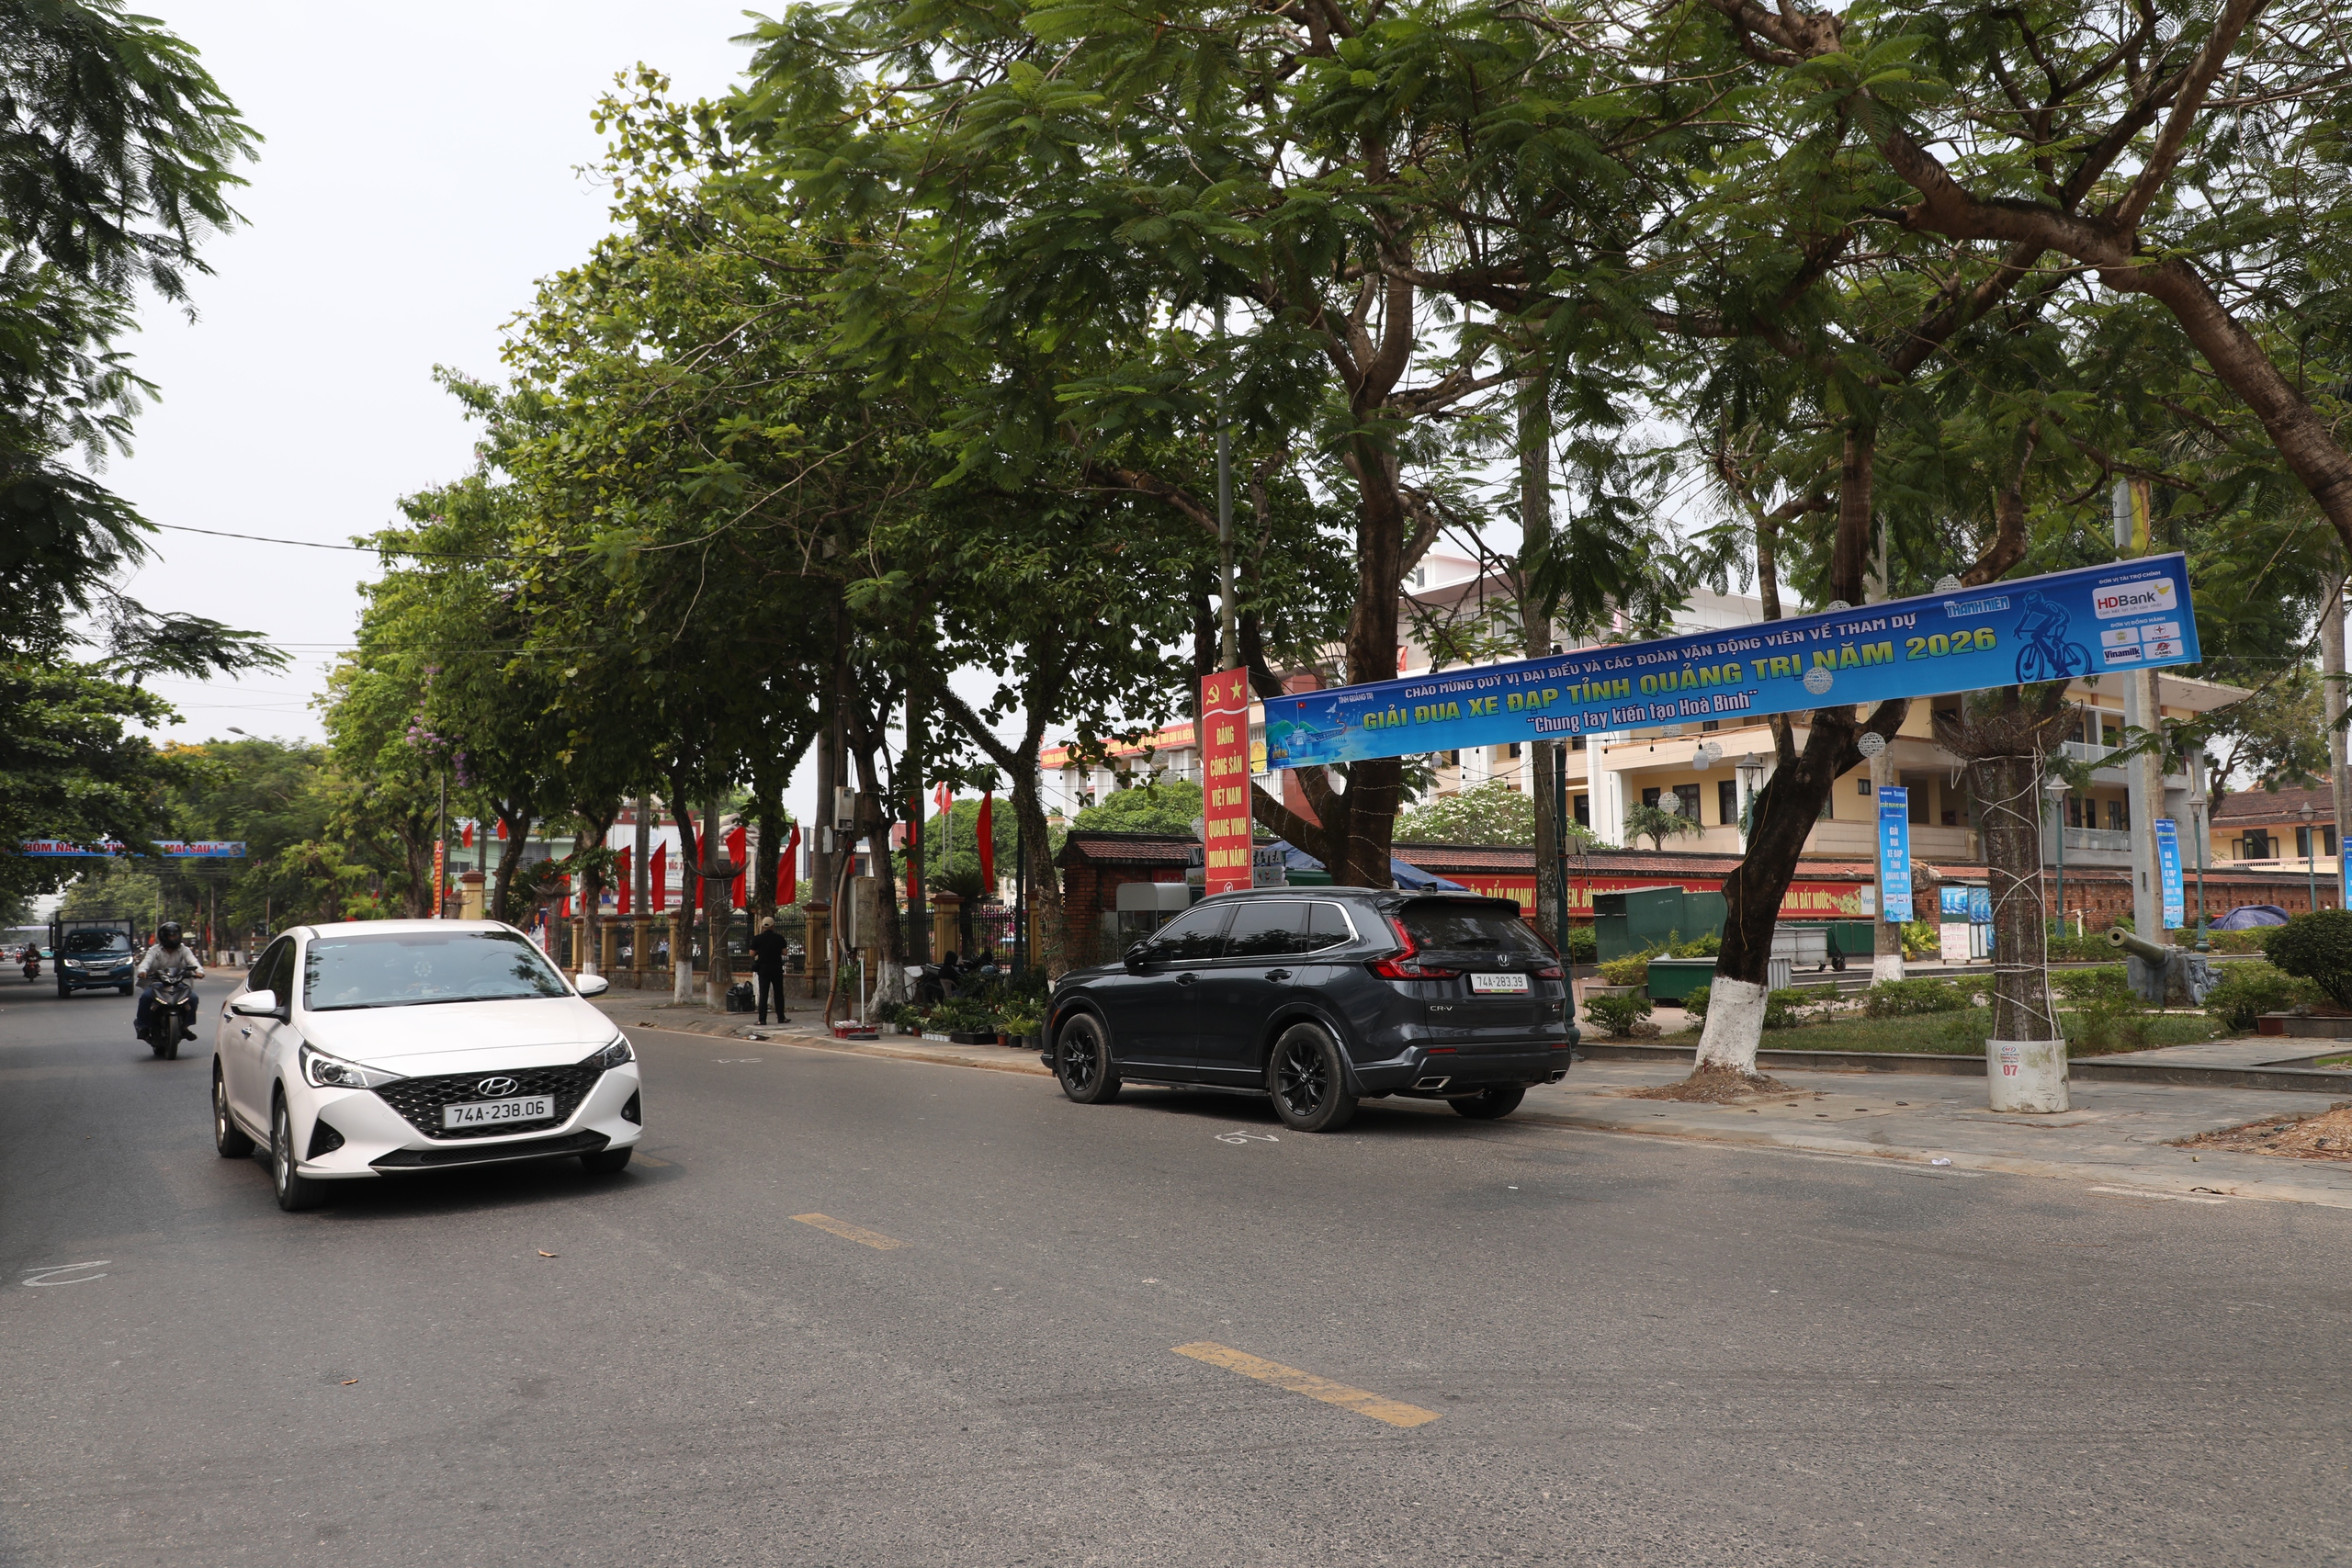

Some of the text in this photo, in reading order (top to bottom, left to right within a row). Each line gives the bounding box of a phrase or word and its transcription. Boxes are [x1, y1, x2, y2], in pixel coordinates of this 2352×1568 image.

[2098, 592, 2156, 609] HDBank
[1405, 612, 1917, 698] CHÀO MỪNG QUÝ VỊ ĐẠI BIỂU VÀ CÁC ĐOÀN VẬN ĐỘNG VIÊN VỀ THAM DỰ
[2104, 648, 2140, 659] Vinamilk
[1363, 626, 1997, 731] GIẢI ĐUA XE ĐẠP TỈNH QUẢNG TRỊ NĂM 2026
[1583, 710, 1608, 729] tay
[1611, 702, 1645, 724] kiến
[1650, 701, 1676, 721] tạo
[1679, 696, 1710, 716] Hoà
[1216, 722, 1235, 746] ĐẢNG
[1210, 750, 1242, 781] CỘNG SẢN
[1211, 785, 1241, 810] VIỆT NAM
[1208, 818, 1247, 840] QUANG VINH
[24, 841, 51, 852] HÔM
[1208, 845, 1248, 868] MUÔN NĂM!
[1786, 887, 1799, 909] HÓA
[1800, 886, 1812, 909] ĐẤT
[1813, 889, 1832, 909] NƯỚC!
[1476, 976, 1523, 987] 74A-283.39
[2003, 1065, 2018, 1077] 07
[454, 1100, 545, 1122] 74A-238.06
